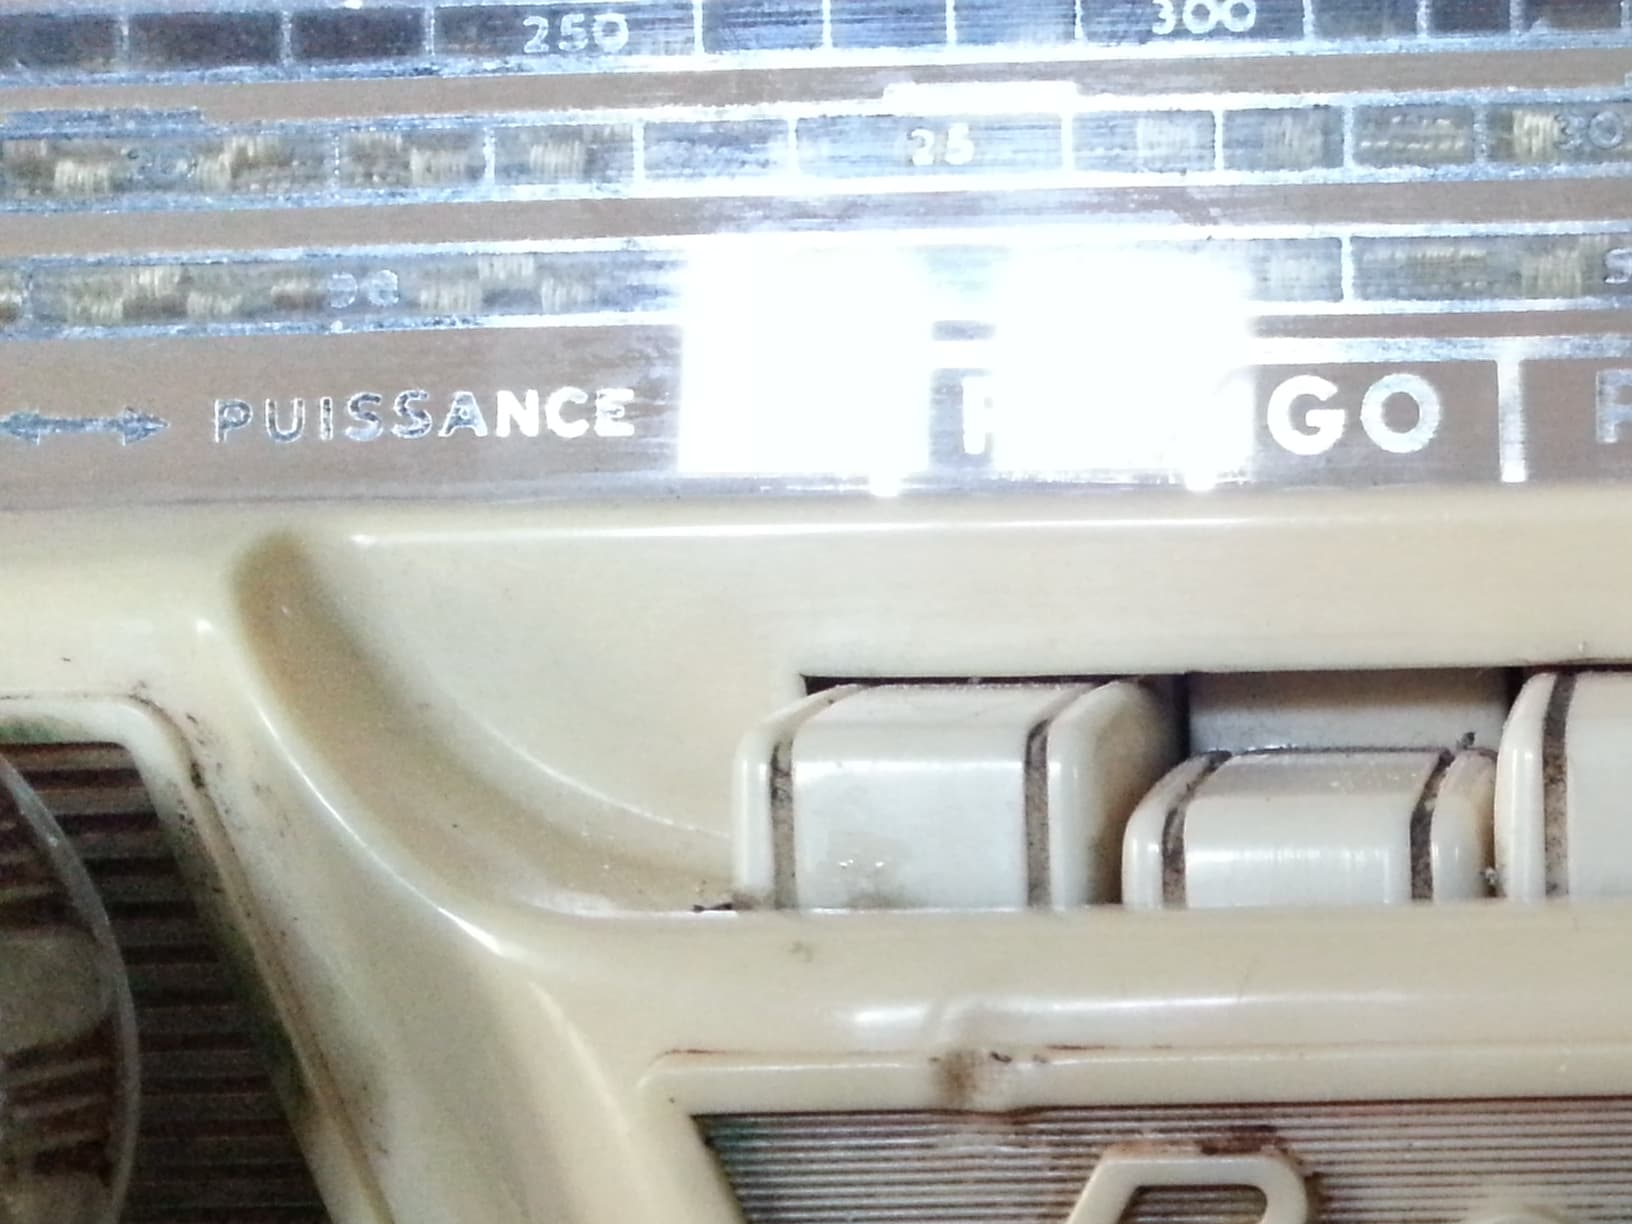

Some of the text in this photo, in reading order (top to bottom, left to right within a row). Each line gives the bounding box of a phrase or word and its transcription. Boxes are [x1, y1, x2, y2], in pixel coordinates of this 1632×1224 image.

[522, 12, 630, 55] 250
[1151, 0, 1257, 35] 300
[907, 129, 975, 165] 25
[213, 386, 636, 444] PUISSANCE
[1266, 372, 1441, 456] GO
